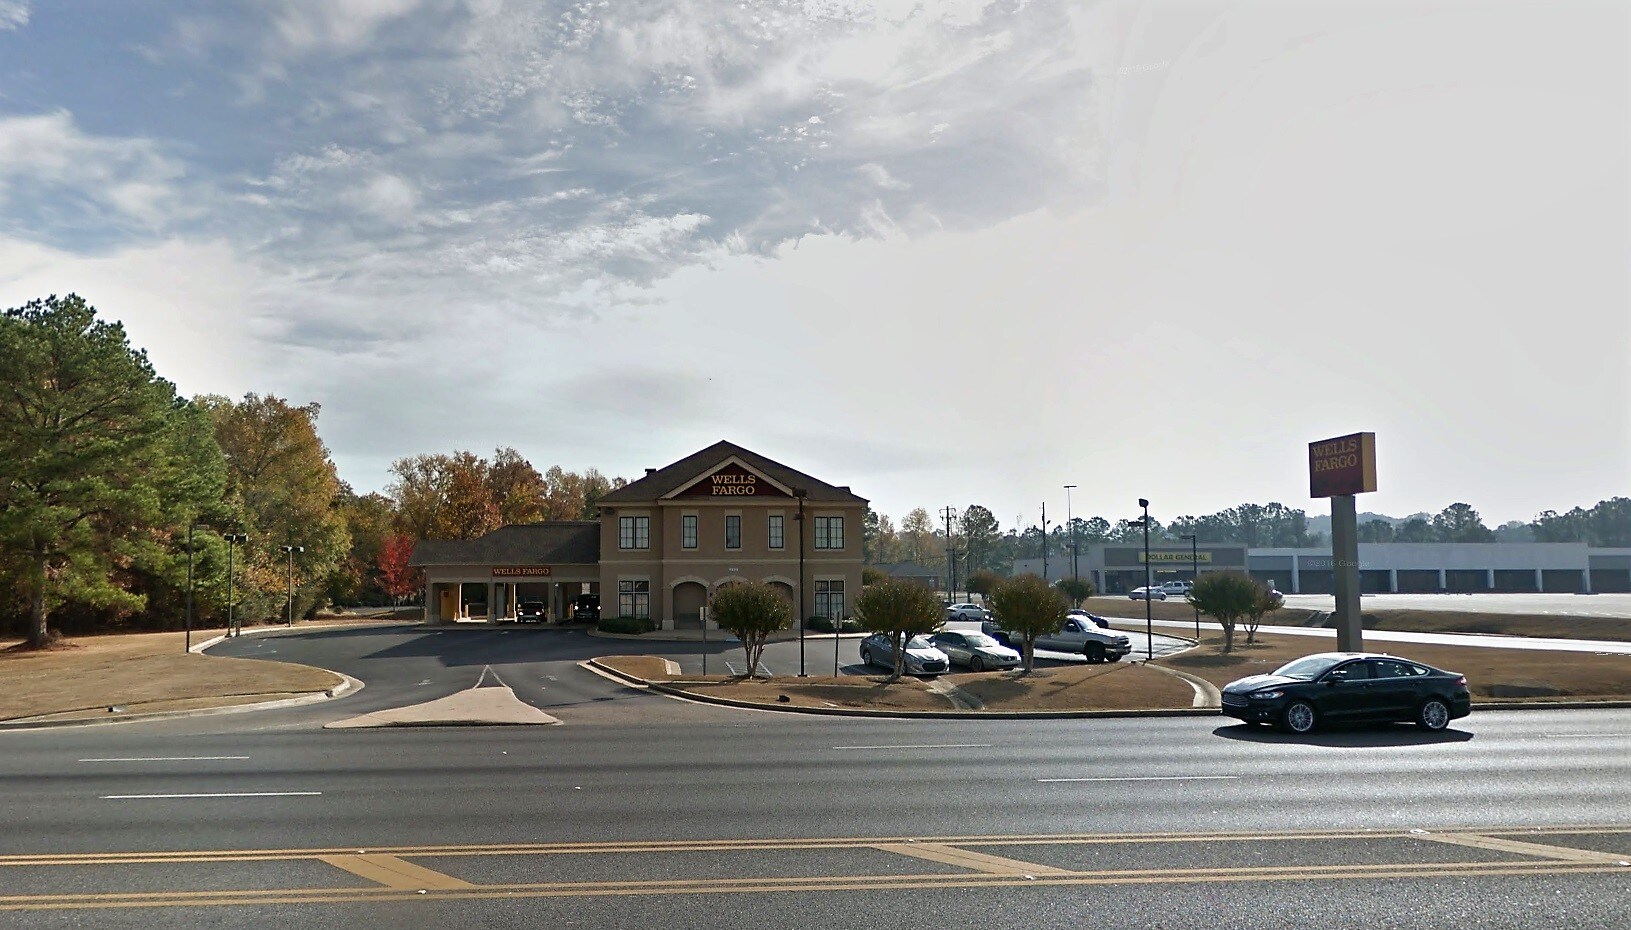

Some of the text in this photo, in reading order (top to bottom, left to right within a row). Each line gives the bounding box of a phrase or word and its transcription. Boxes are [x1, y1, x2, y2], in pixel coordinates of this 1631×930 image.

[1312, 439, 1357, 457] WELLS
[1314, 454, 1357, 472] FARGO
[711, 475, 756, 484] WELLS
[712, 485, 755, 495] FARGO
